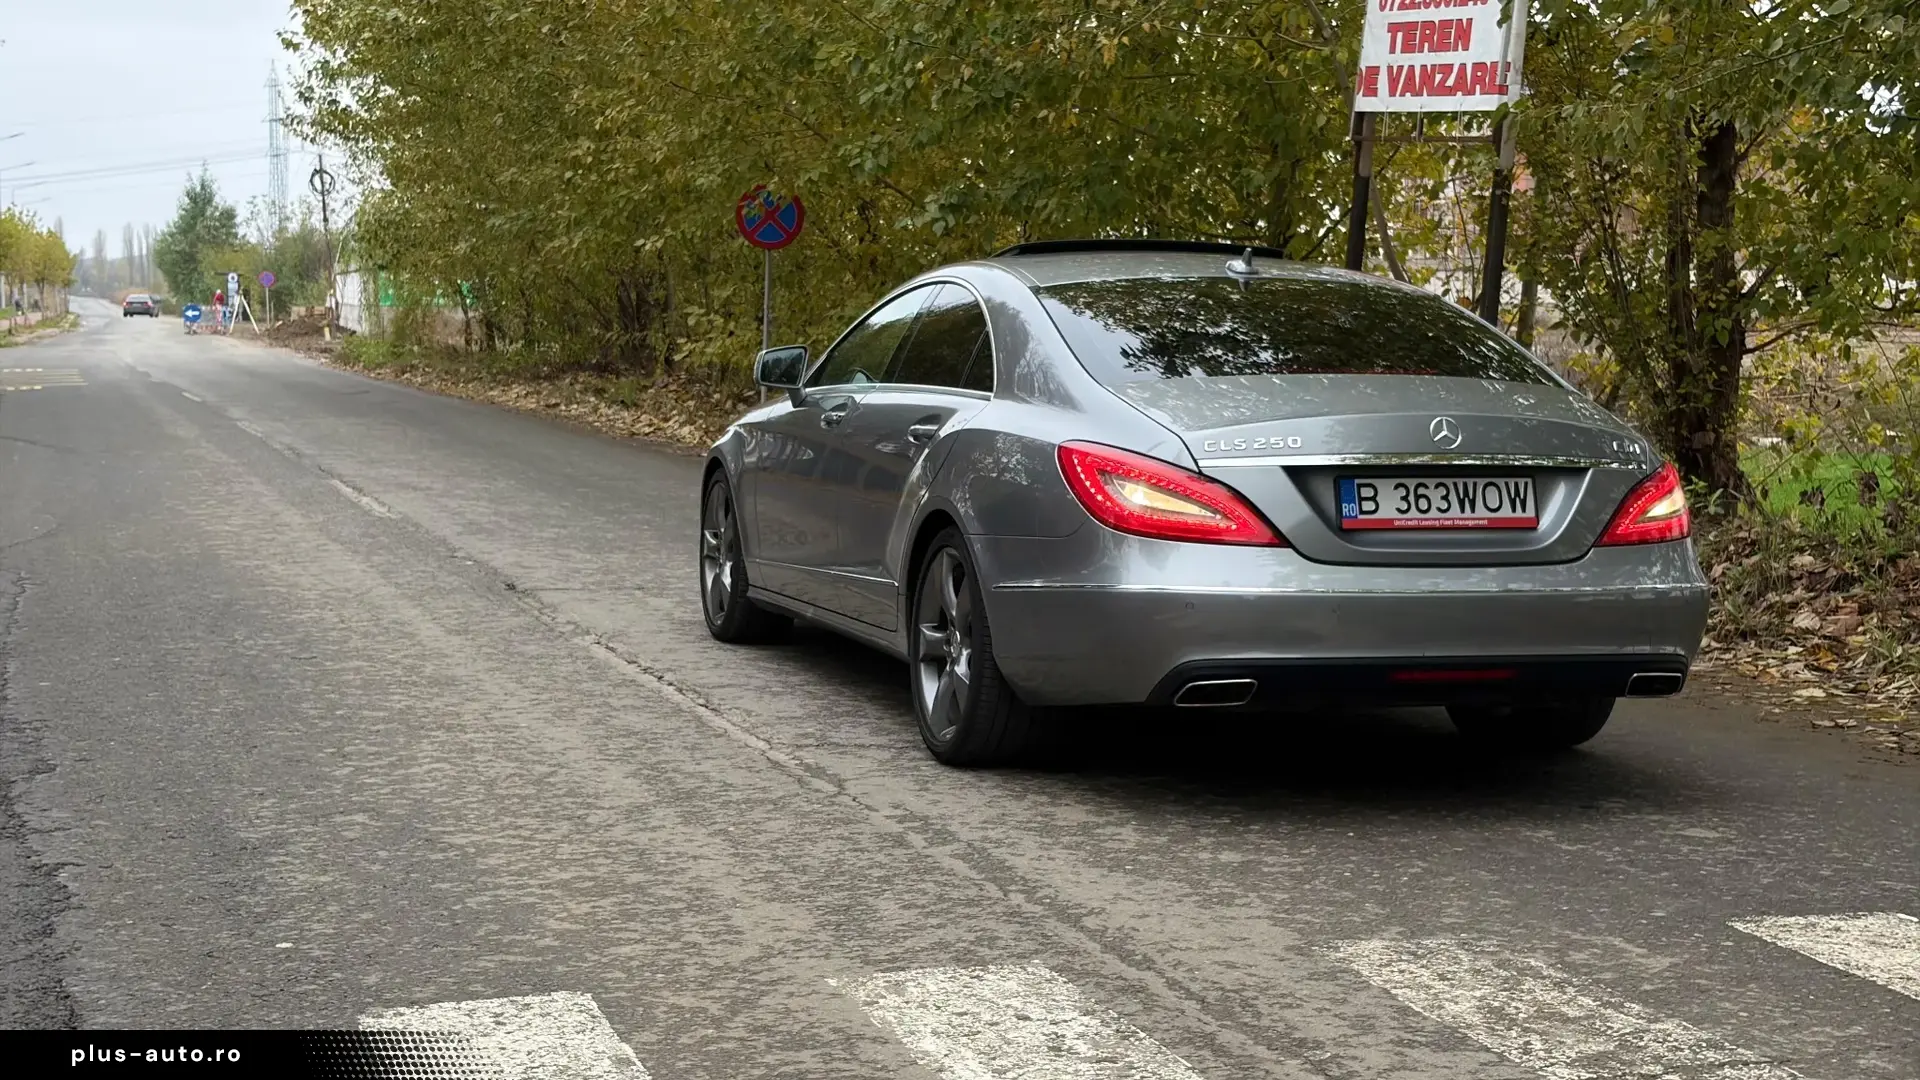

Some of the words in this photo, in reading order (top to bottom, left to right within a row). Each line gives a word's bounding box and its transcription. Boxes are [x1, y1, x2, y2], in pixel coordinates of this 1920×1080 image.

[1387, 18, 1473, 54] TEREN
[1387, 61, 1511, 97] VANZARE
[1204, 438, 1247, 452] CLS
[1253, 436, 1302, 450] 250
[1342, 503, 1357, 517] RO
[1356, 482, 1380, 516] B
[1392, 480, 1529, 515] 363WOW
[1454, 519, 1488, 527] Management
